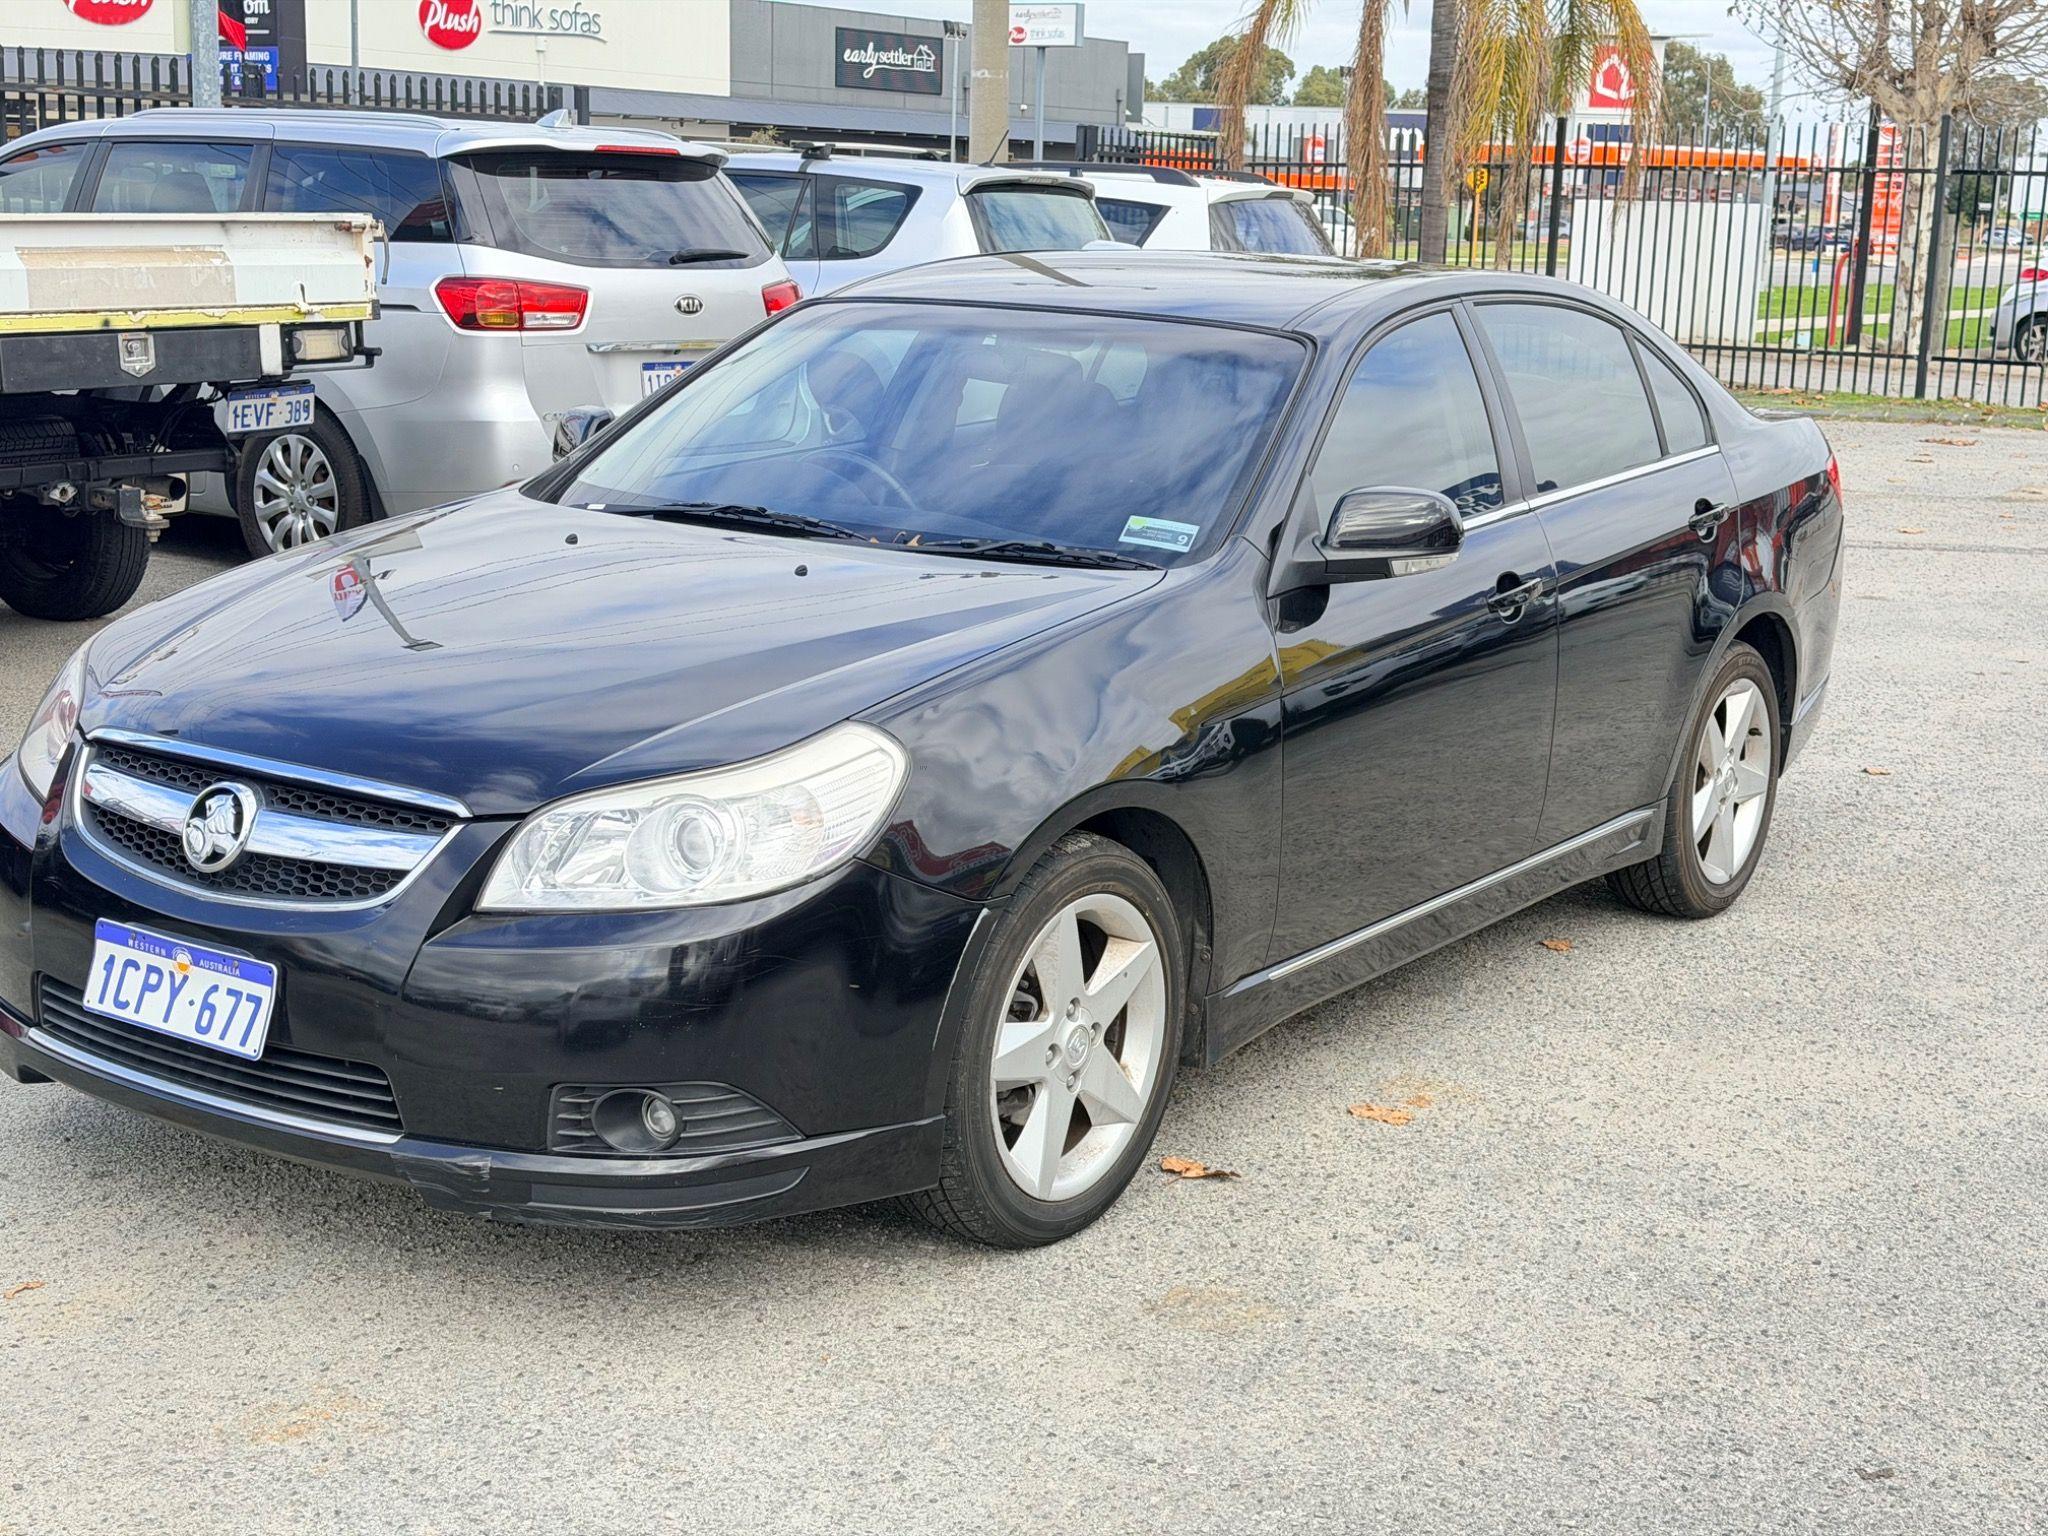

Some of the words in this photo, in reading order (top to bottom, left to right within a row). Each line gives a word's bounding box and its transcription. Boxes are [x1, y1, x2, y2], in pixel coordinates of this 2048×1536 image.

[424, 0, 480, 38] Plush
[490, 0, 543, 28] think
[549, 2, 602, 34] sofas
[843, 41, 878, 78] early
[879, 47, 914, 65] settler
[680, 298, 700, 312] KIA
[1176, 534, 1188, 545] 9
[127, 938, 167, 958] WESTERN
[199, 959, 241, 977] AUSTRALIA
